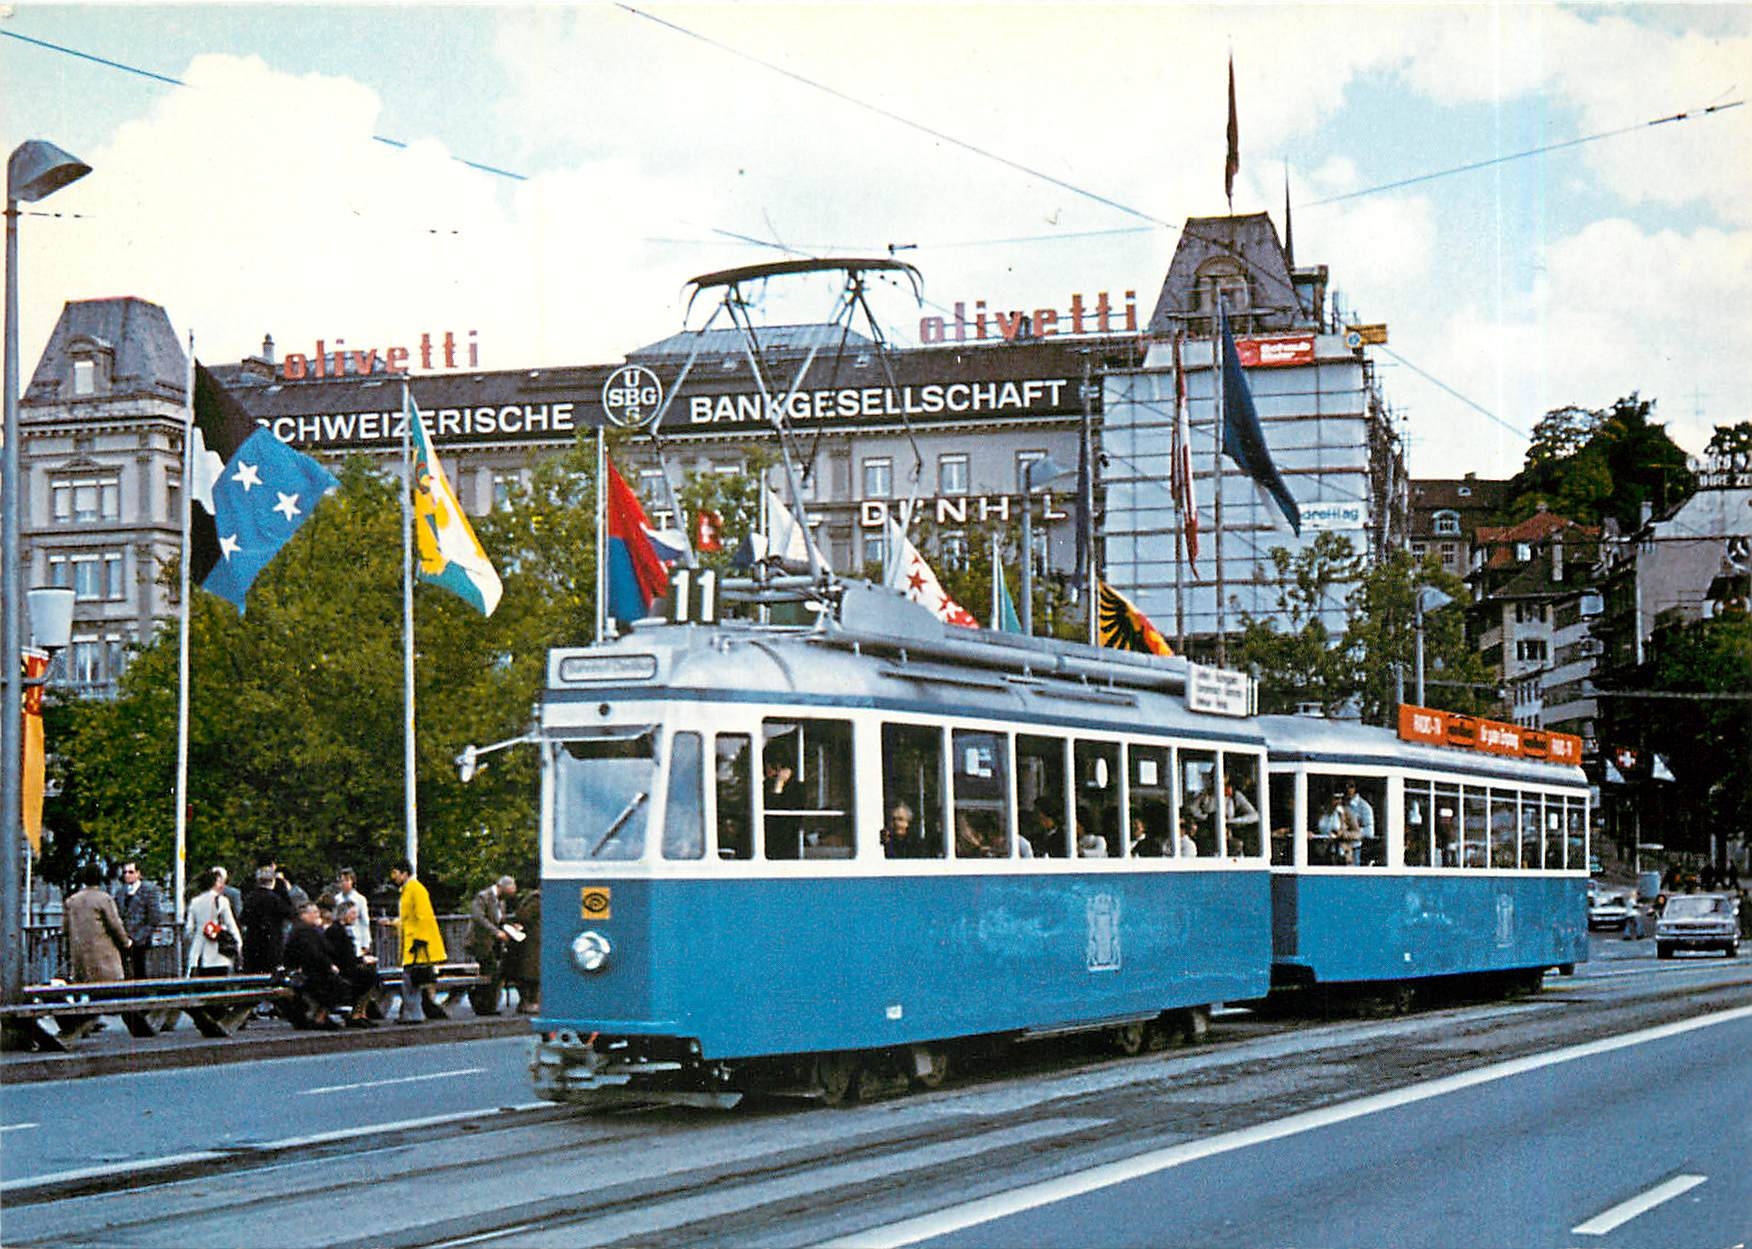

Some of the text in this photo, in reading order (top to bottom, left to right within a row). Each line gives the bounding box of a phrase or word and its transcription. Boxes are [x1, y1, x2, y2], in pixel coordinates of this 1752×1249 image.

[919, 290, 1136, 344] olivetti
[283, 330, 478, 380] olivetti
[256, 403, 575, 443] CHWEIZERISCHE
[690, 380, 1067, 424] BANKGESELLSCHAFT
[671, 569, 716, 622] 11
